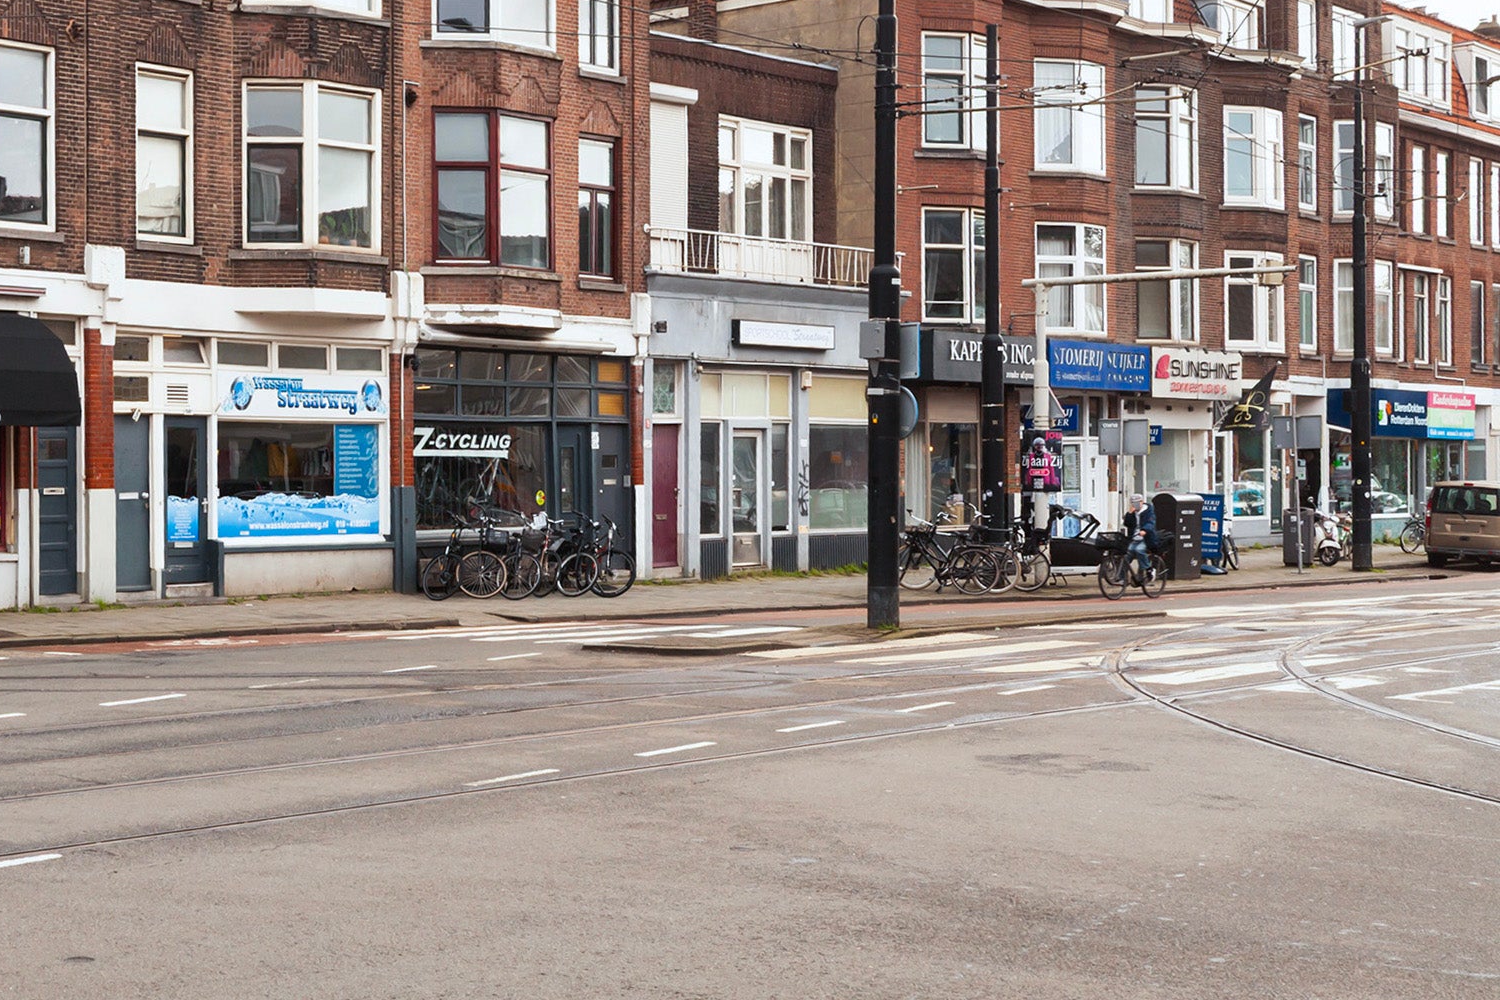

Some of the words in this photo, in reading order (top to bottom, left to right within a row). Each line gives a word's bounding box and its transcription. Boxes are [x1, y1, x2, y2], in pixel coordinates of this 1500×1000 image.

[1054, 347, 1103, 371] STOMERIJ
[1171, 360, 1238, 380] SUNSHINE
[277, 389, 358, 415] Straatweg
[413, 427, 512, 457] Z-CYCLING
[1031, 457, 1048, 467] aan
[1050, 455, 1063, 469] Zij
